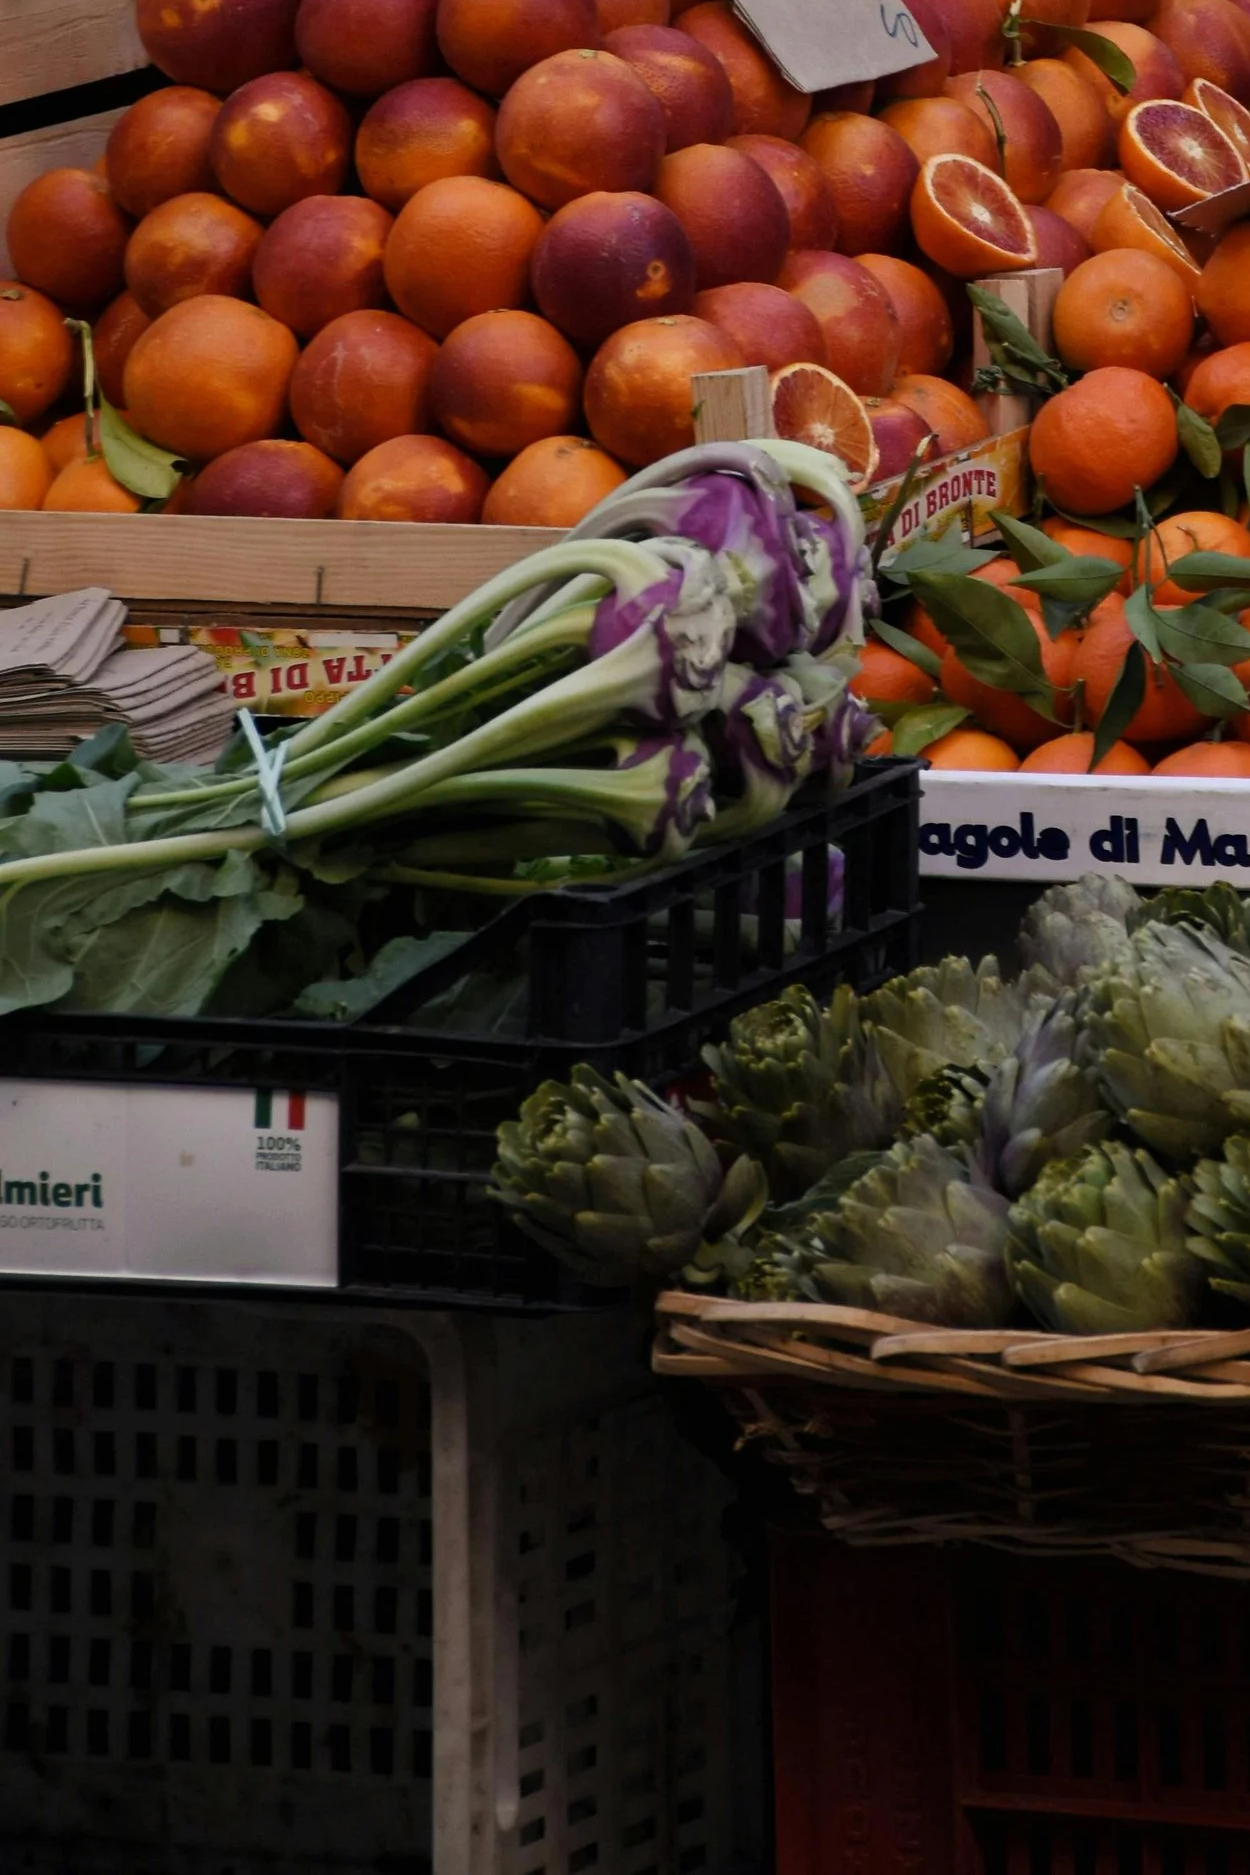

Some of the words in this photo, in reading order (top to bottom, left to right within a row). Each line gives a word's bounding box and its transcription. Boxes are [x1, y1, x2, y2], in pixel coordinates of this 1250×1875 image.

[925, 469, 998, 519] BRONTE
[269, 662, 310, 694] DI
[1089, 811, 1141, 865] di
[256, 1135, 302, 1151] 100%
[0, 1170, 103, 1209] mieri
